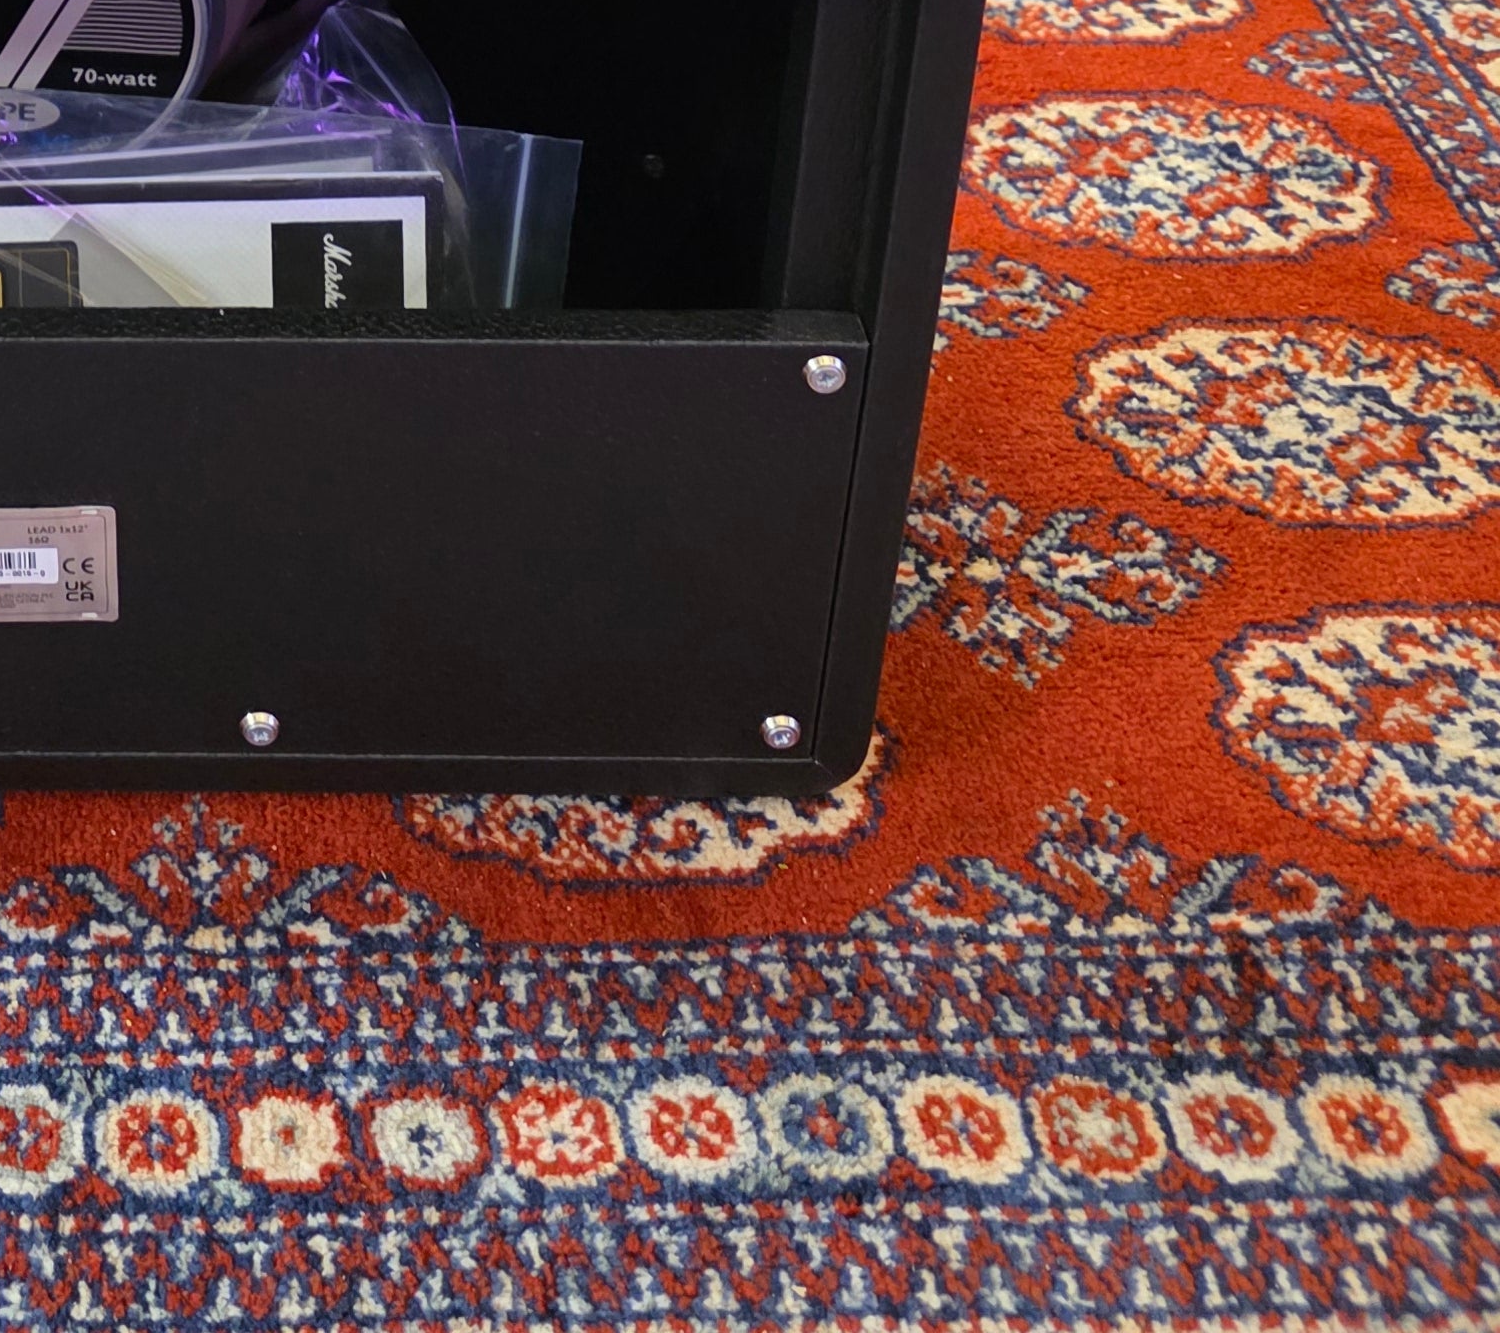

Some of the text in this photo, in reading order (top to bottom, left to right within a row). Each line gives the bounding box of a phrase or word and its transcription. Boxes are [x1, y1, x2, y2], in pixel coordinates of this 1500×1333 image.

[72, 67, 158, 88] 70-watt
[27, 526, 56, 534] LEAD
[63, 557, 95, 575] CE
[65, 582, 91, 591] UK
[66, 592, 94, 601] CA
